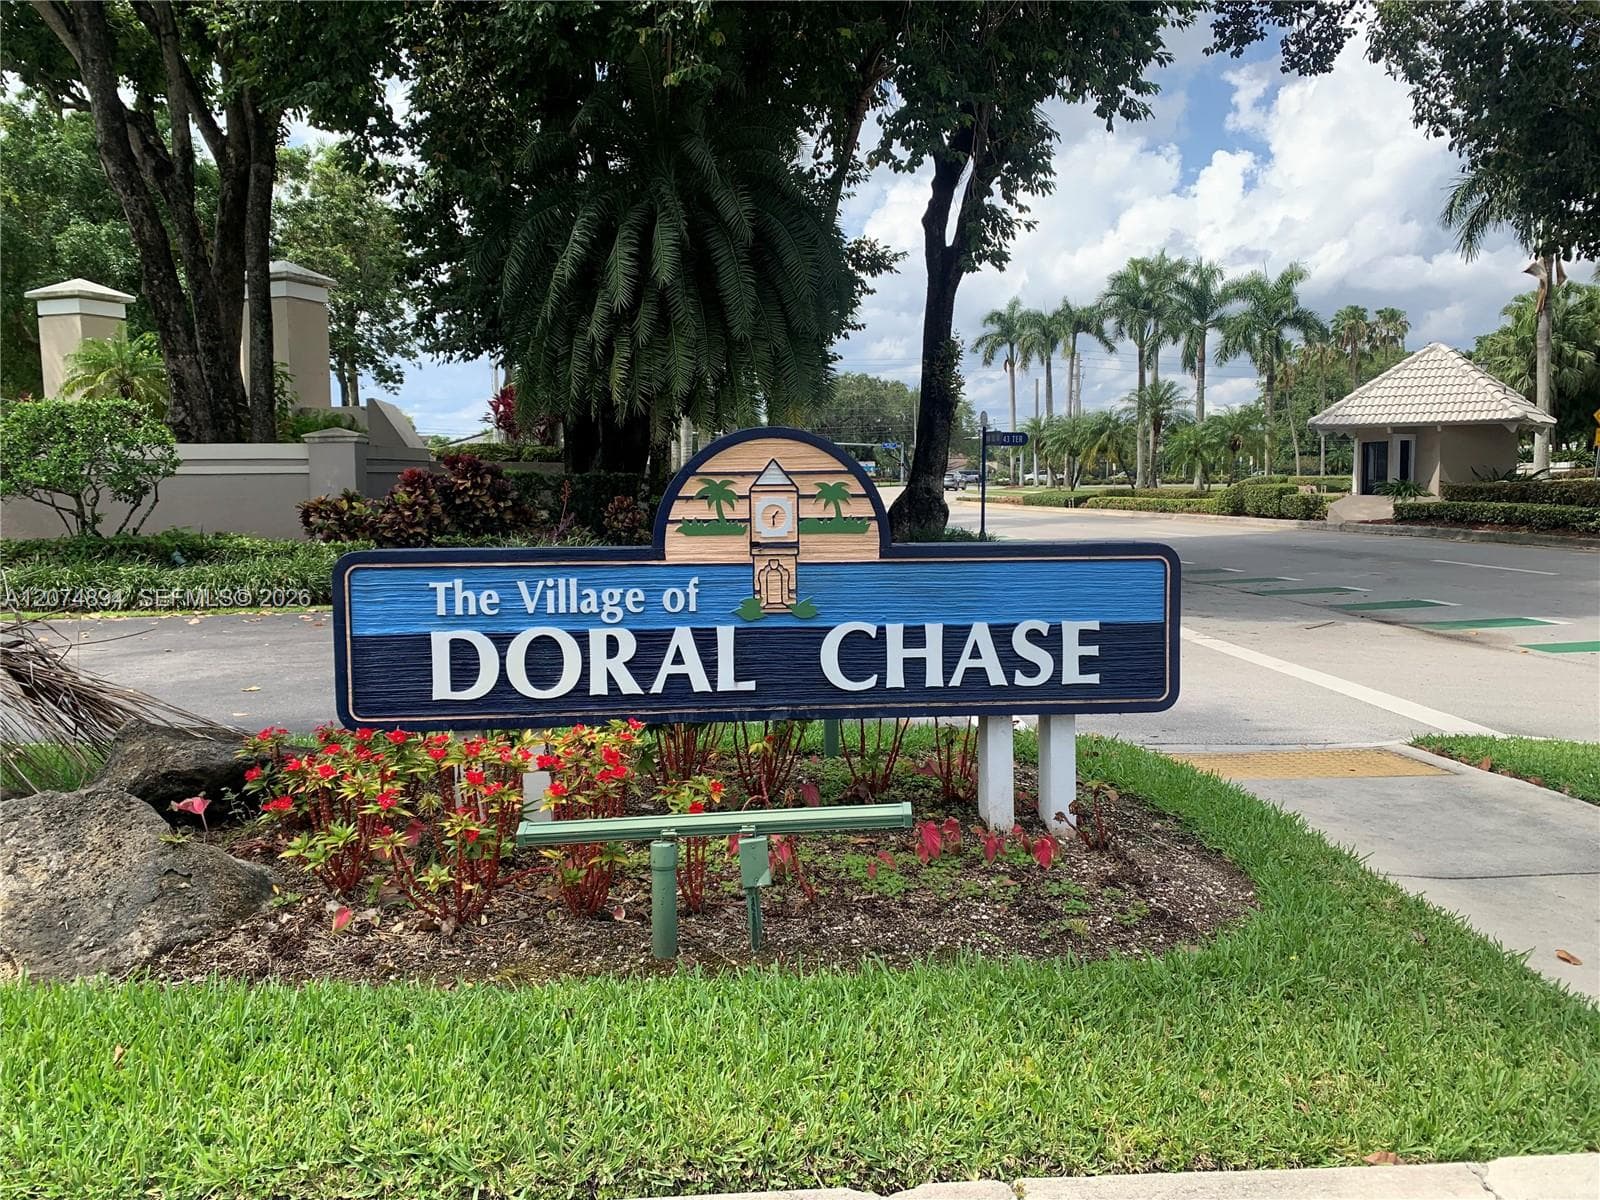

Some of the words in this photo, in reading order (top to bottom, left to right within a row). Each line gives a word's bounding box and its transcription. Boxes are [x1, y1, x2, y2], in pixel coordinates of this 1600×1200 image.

[1012, 435, 1023, 443] TER
[429, 579, 500, 616] The
[516, 577, 645, 624] Village
[662, 577, 699, 613] of
[430, 625, 756, 701] DORAL
[819, 620, 1101, 692] CHASE
